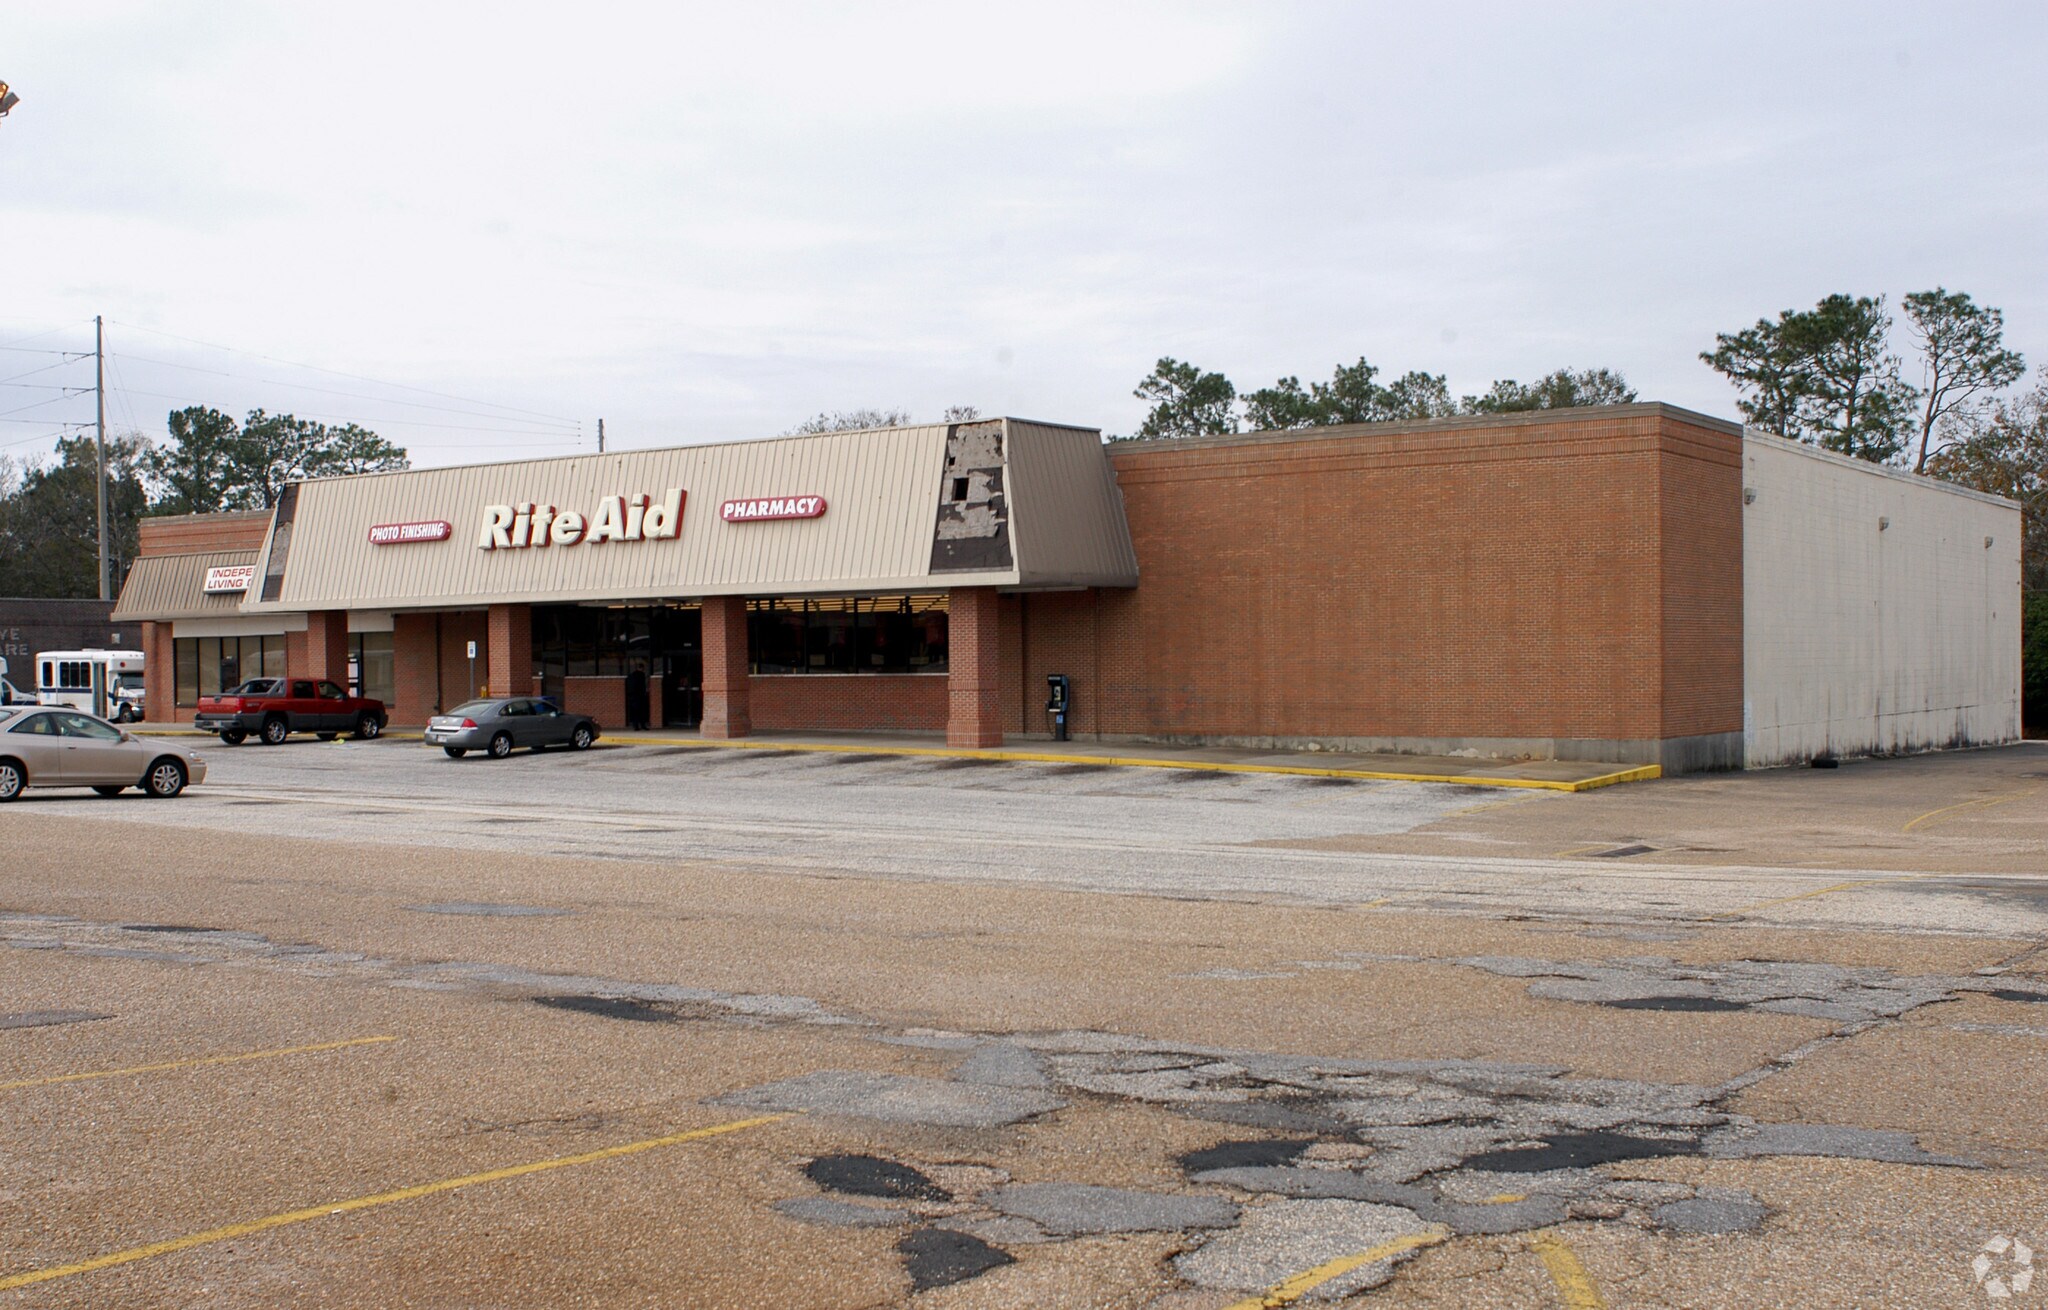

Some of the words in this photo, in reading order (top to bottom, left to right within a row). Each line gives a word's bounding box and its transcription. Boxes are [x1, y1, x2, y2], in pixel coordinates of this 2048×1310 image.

[723, 497, 818, 518] PHARMACY
[478, 502, 585, 549] Rite
[586, 488, 686, 542] Aid
[370, 526, 399, 541] PHOTO
[400, 522, 444, 539] FINISHING
[207, 578, 243, 589] LIVING
